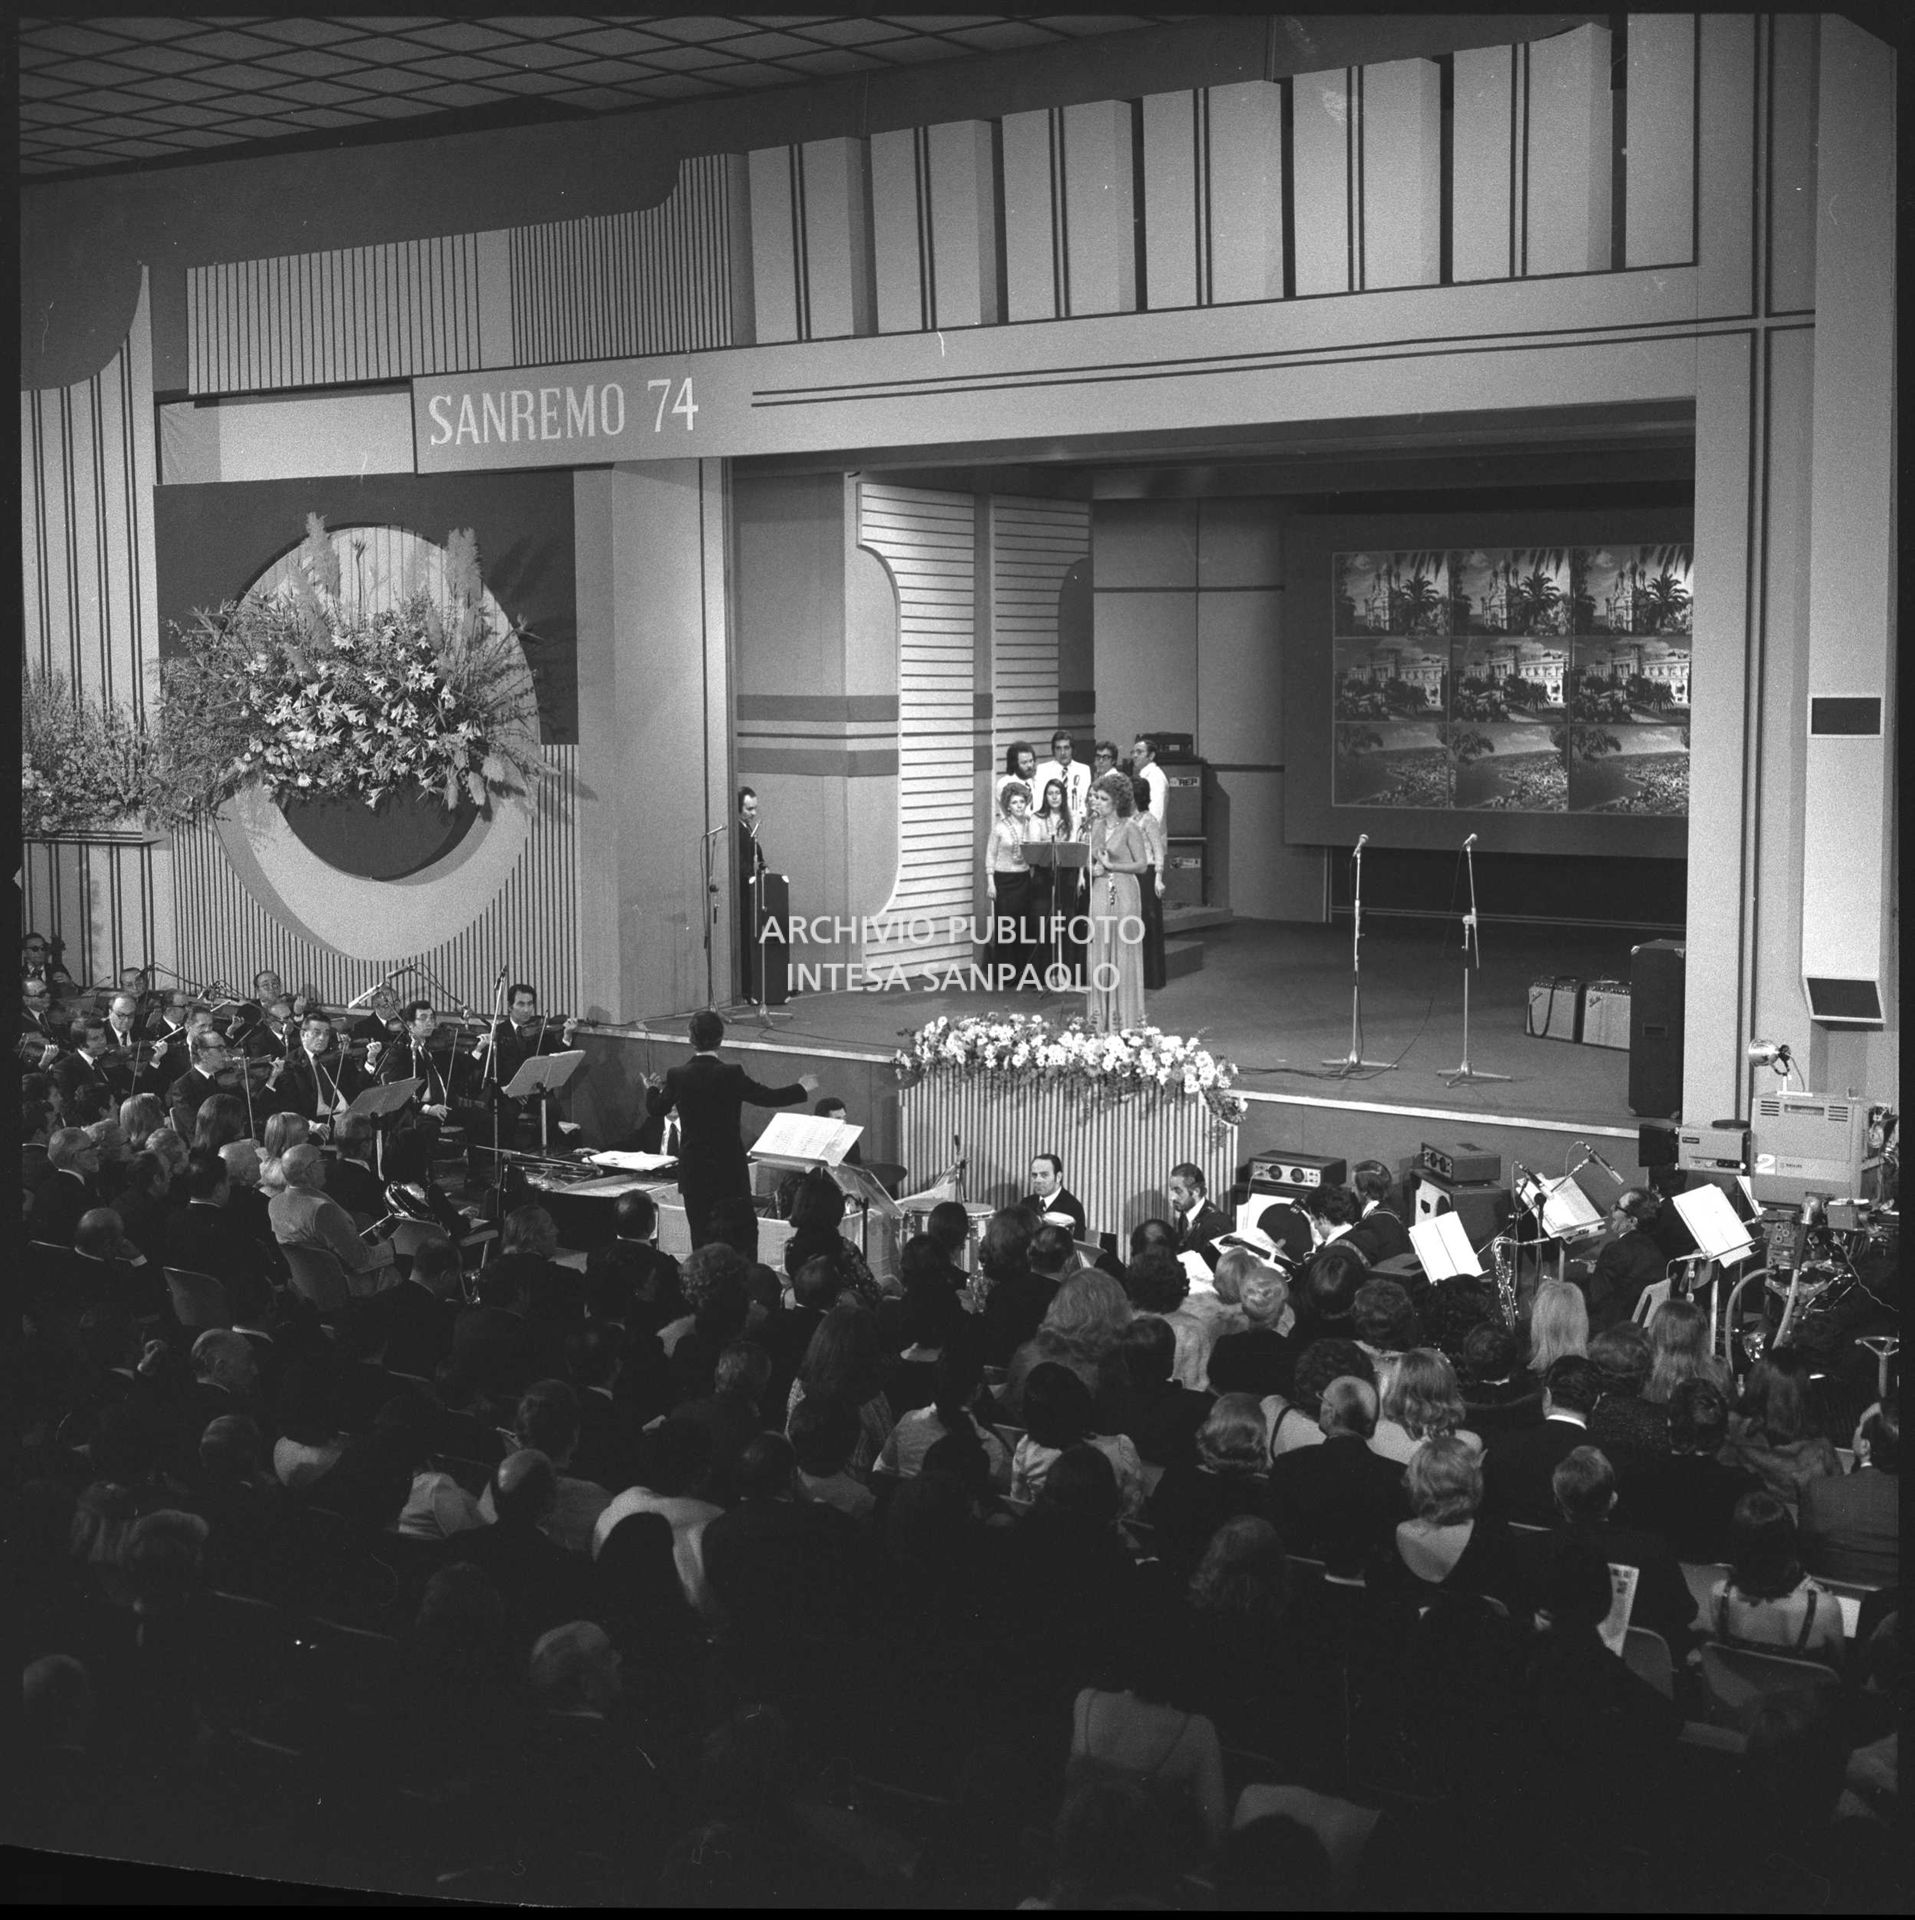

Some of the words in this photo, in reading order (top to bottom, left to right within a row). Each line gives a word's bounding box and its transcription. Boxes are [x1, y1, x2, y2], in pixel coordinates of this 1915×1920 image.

[428, 383, 625, 446] SANREMO
[647, 377, 699, 433] 74
[1756, 1153, 1775, 1174] 2
